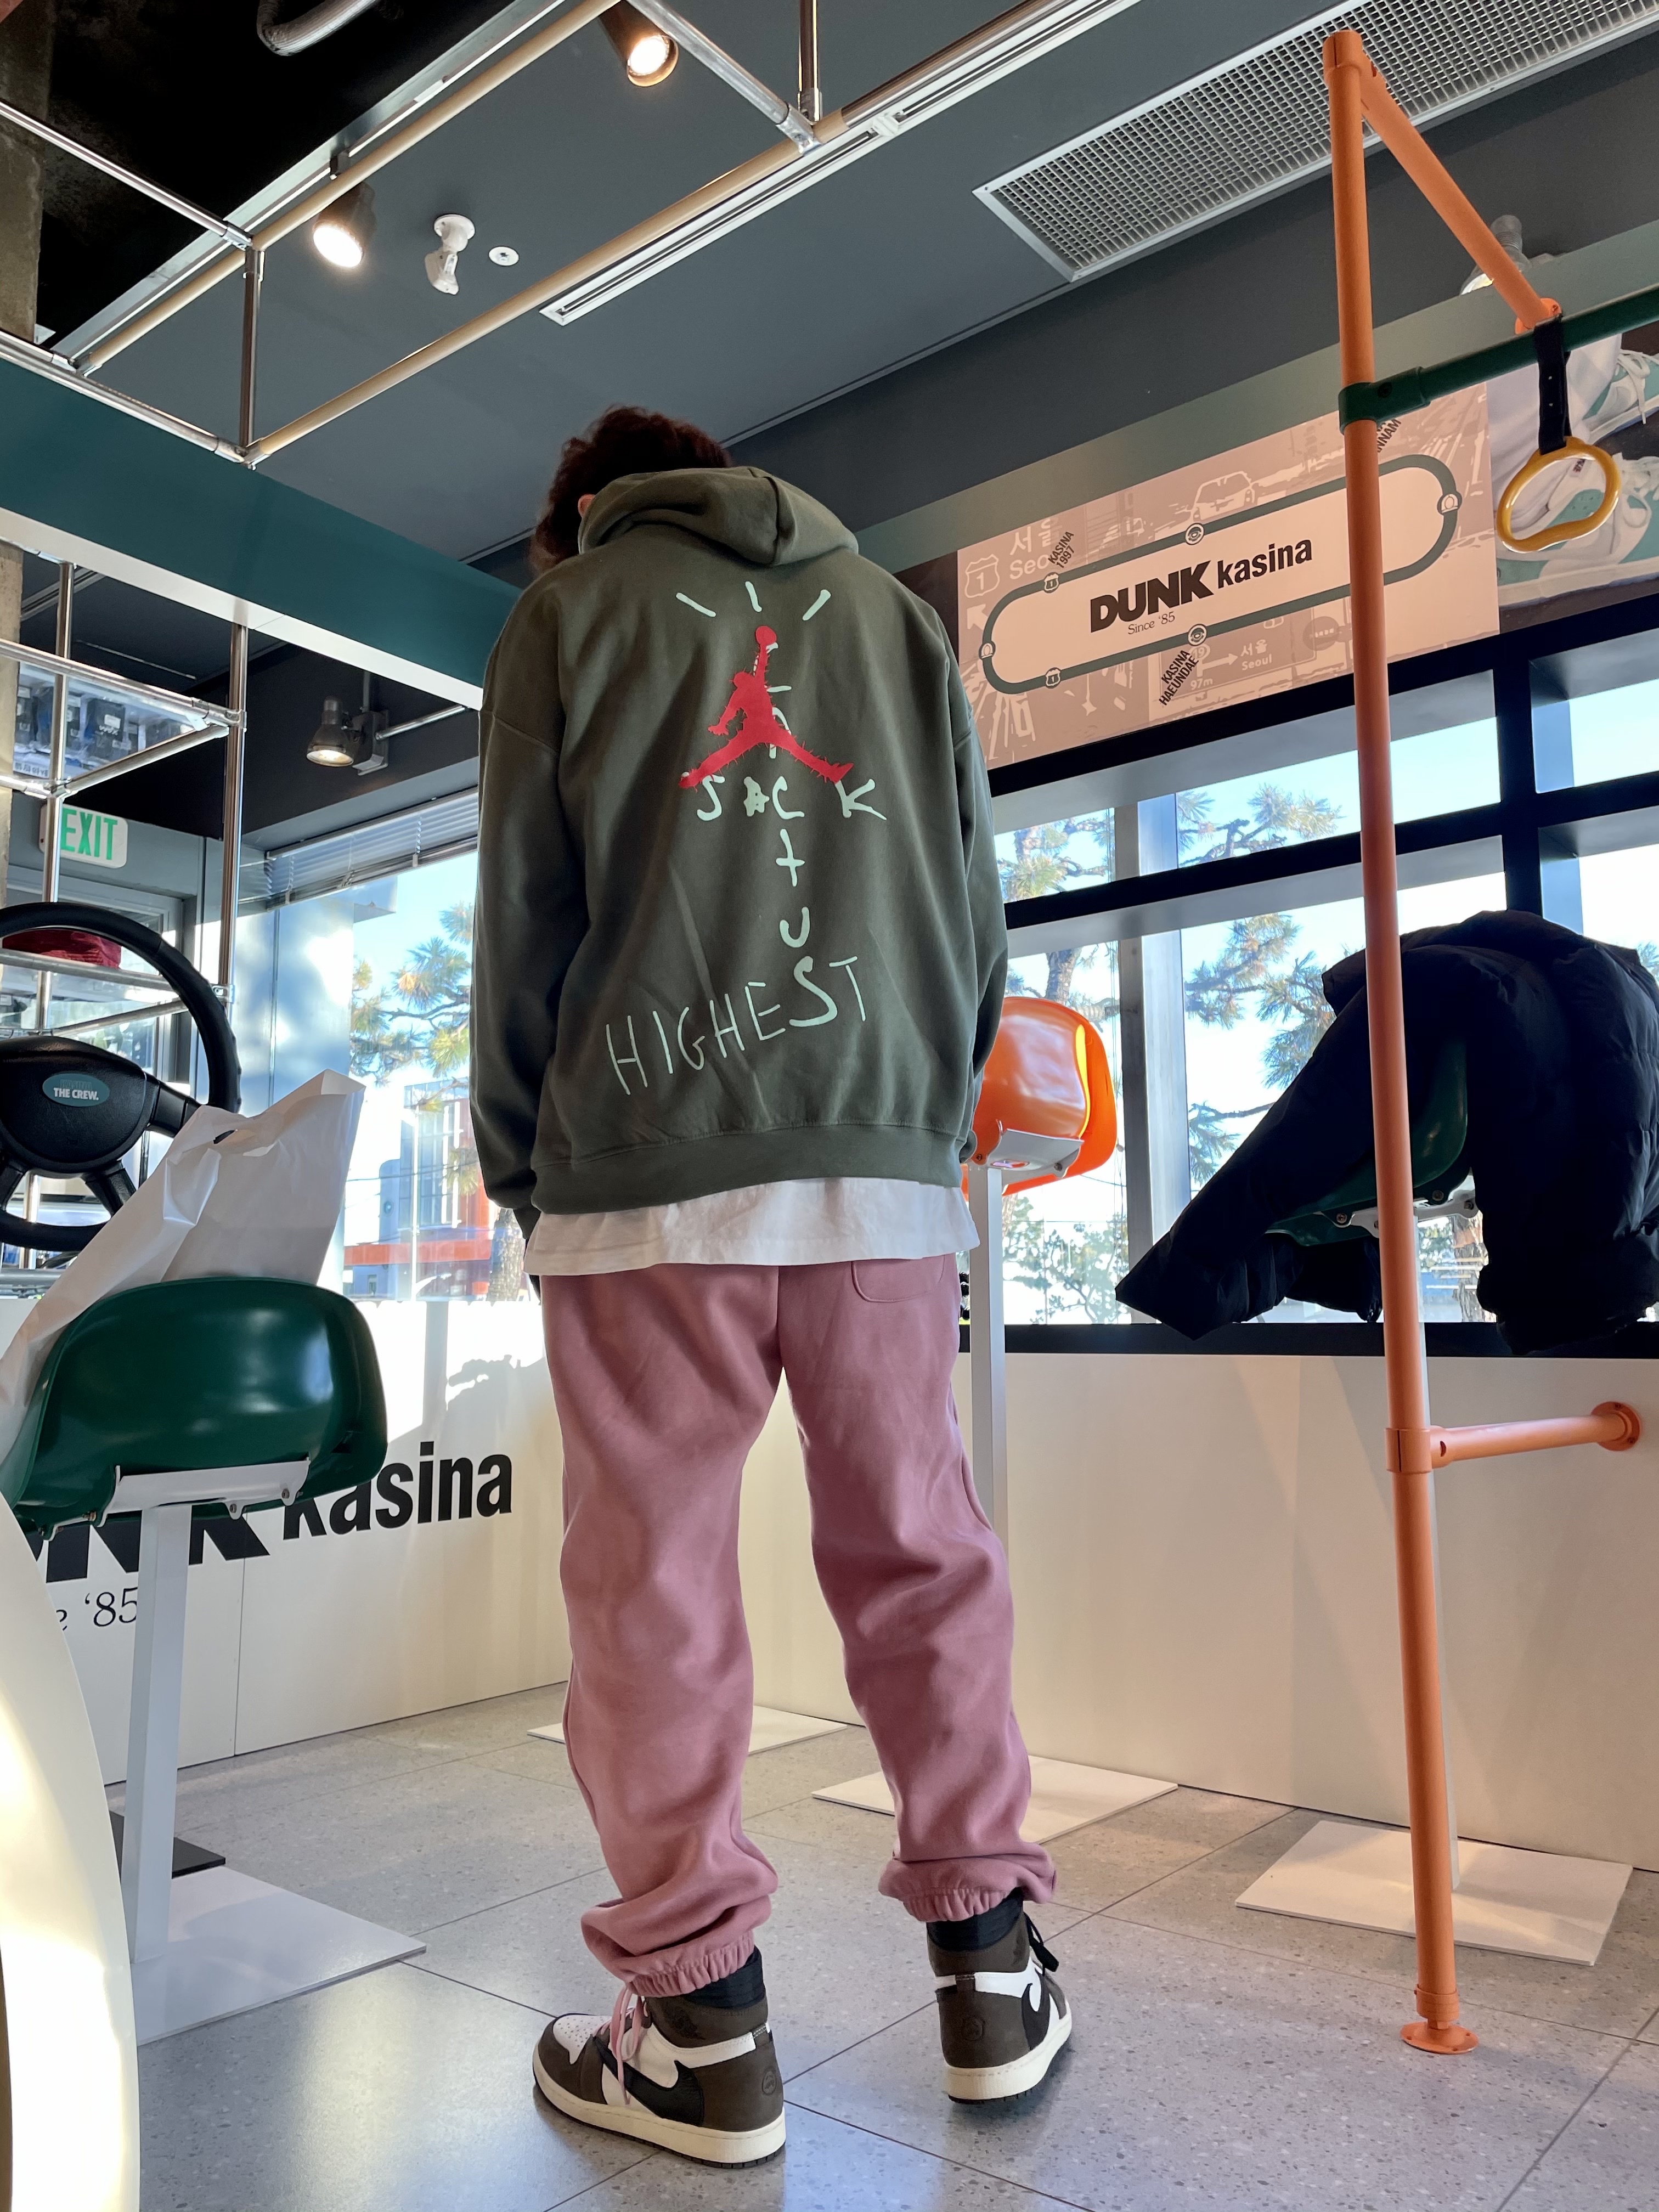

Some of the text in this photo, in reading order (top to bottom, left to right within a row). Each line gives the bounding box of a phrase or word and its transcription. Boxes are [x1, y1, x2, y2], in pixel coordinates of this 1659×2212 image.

[1048, 531, 1075, 565] KASINA
[1056, 545, 1075, 569] 1997
[1090, 539, 1313, 633] DUNK kasina
[1127, 620, 1155, 635] Since
[1161, 650, 1191, 685] KASINA
[1242, 653, 1272, 671] Seoul
[1158, 655, 1199, 706] HAEUNDAE
[60, 808, 118, 860] EXIT
[606, 956, 867, 1095] HIGHEST
[53, 1087, 99, 1101] THE CREW.
